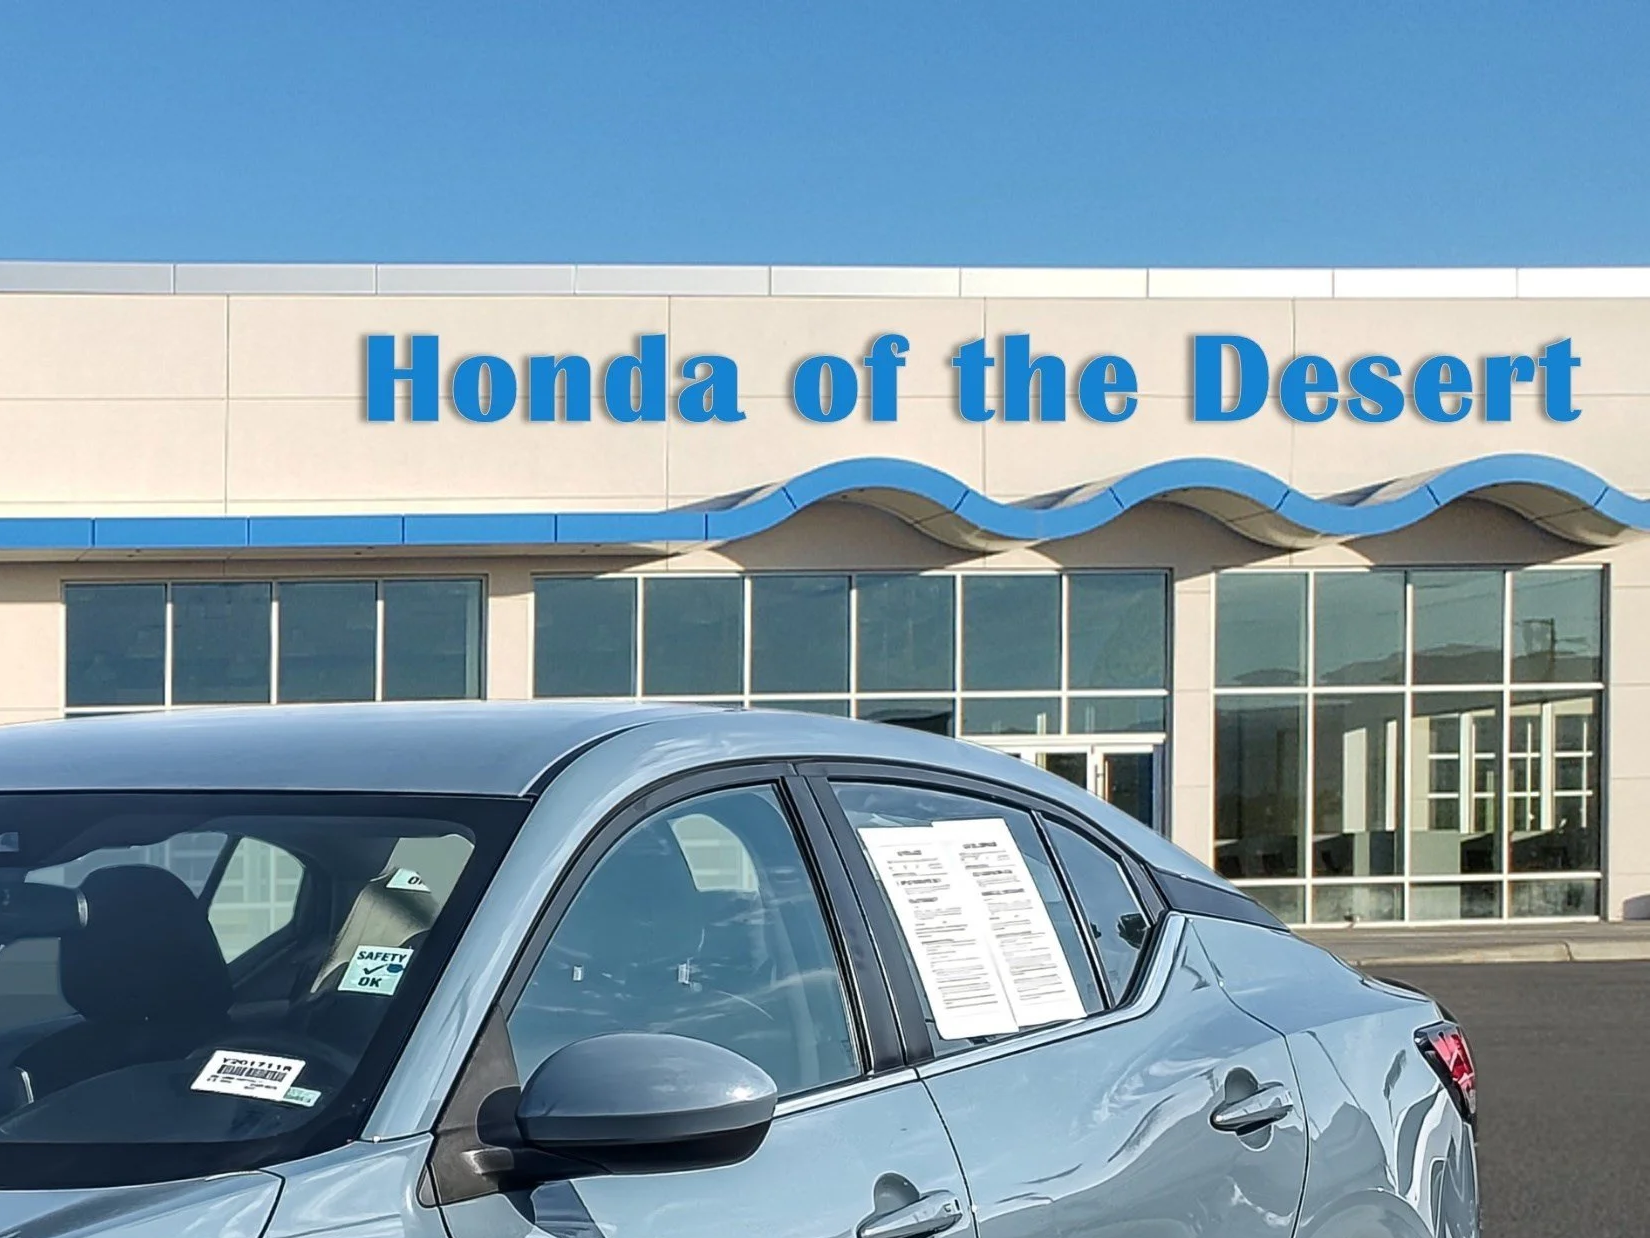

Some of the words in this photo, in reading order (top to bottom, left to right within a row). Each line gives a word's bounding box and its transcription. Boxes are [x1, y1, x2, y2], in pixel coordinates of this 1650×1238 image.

[367, 334, 746, 423] Honda
[793, 333, 908, 423] of
[952, 333, 1138, 423] the
[1194, 334, 1582, 423] Desert
[357, 950, 407, 963] SAFETY
[358, 977, 382, 988] OK
